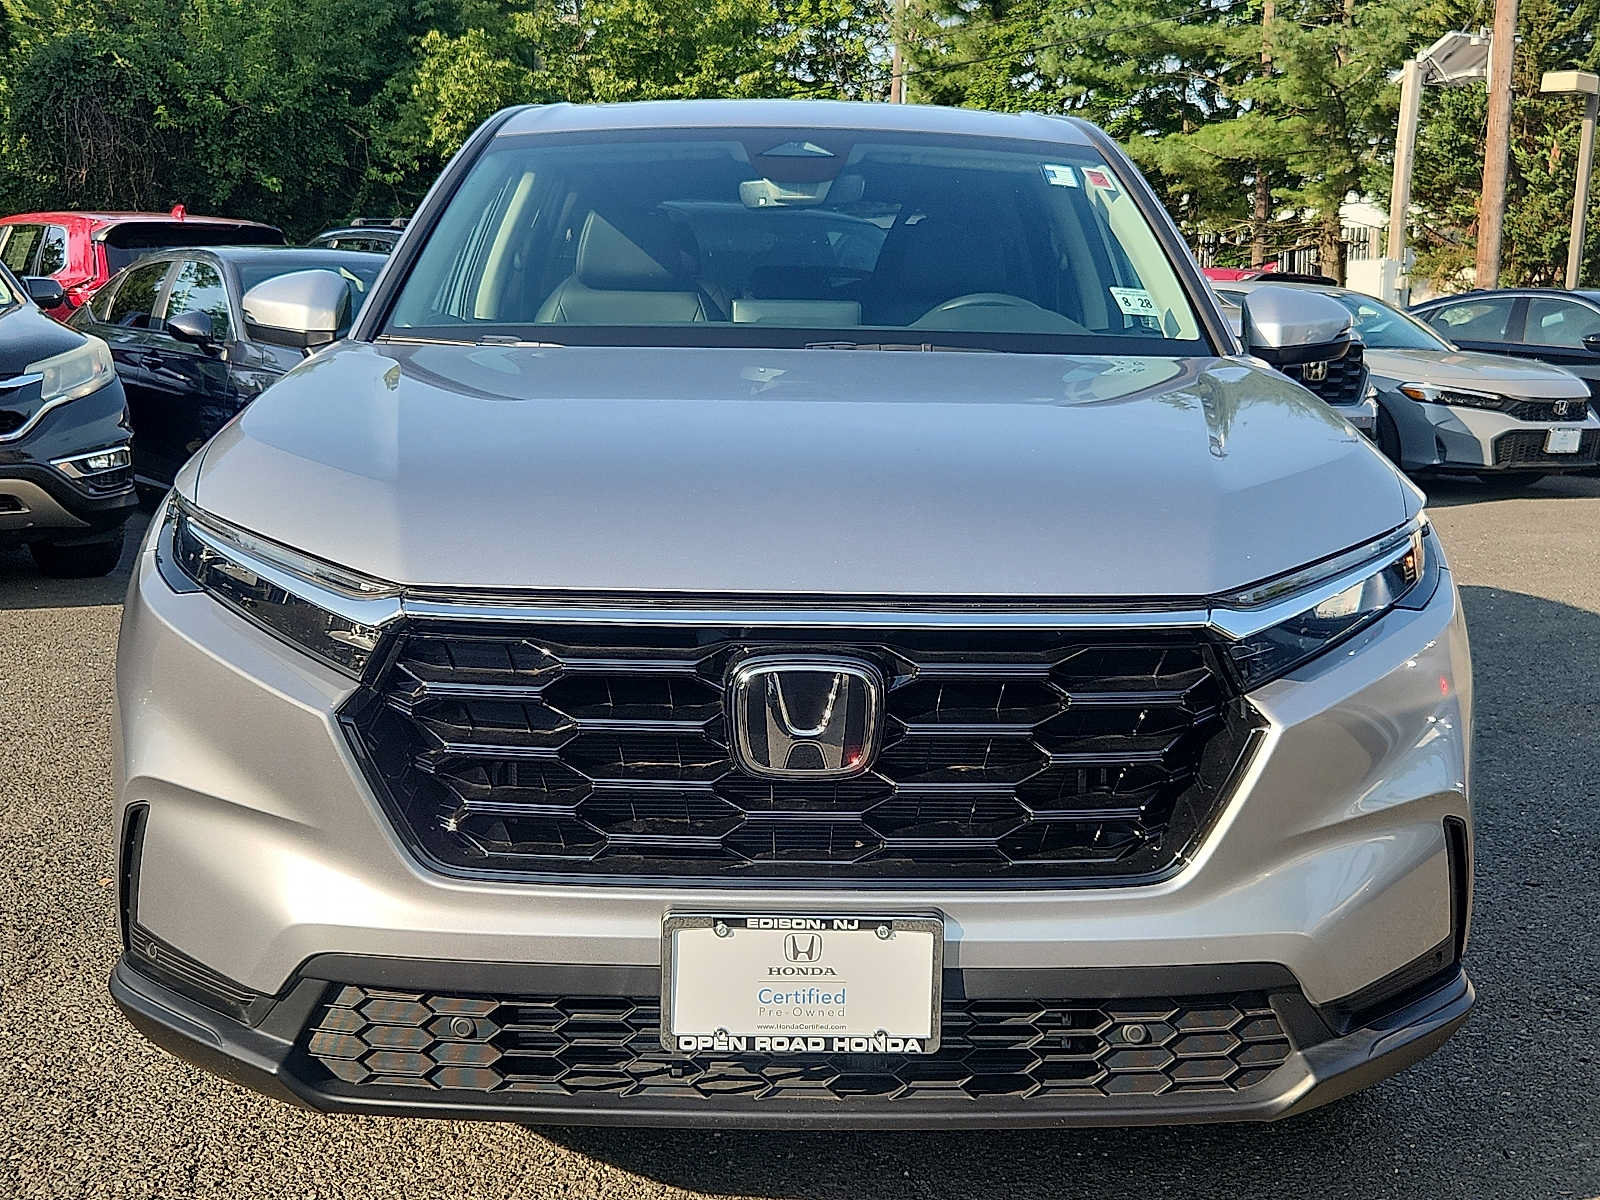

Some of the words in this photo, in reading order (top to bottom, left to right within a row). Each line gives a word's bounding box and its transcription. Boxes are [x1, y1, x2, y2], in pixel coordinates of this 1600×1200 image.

[1122, 297, 1131, 307] 8
[1138, 298, 1152, 308] 28
[746, 918, 826, 930] EDISON,
[833, 919, 859, 930] NJ
[768, 966, 837, 976] HONDA
[758, 988, 846, 1004] Certified
[759, 1007, 845, 1017] Pre-Owned
[679, 1036, 747, 1051] OPEN
[755, 1037, 825, 1052] ROAD
[833, 1038, 922, 1053] HONDA
